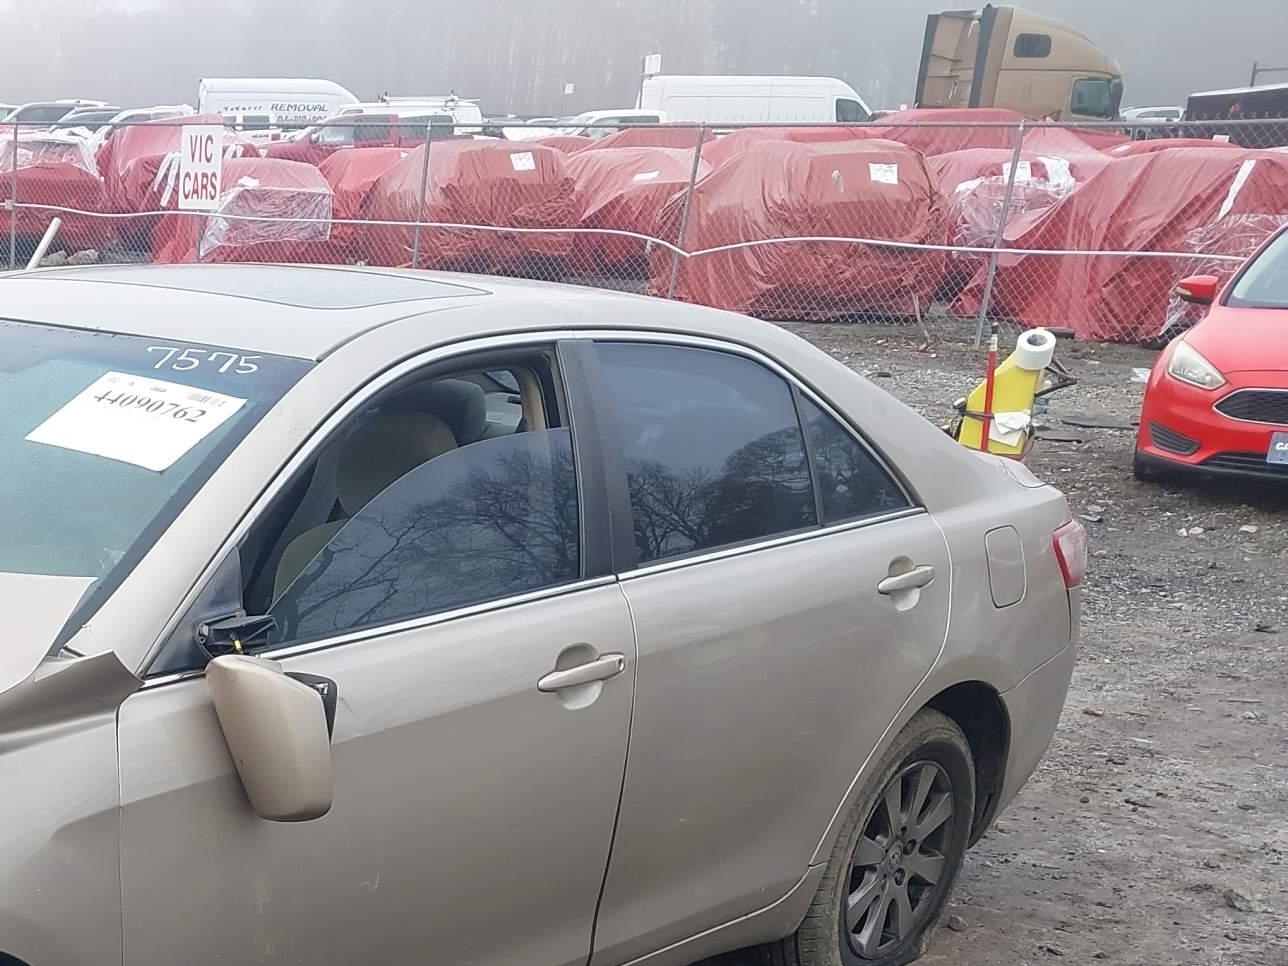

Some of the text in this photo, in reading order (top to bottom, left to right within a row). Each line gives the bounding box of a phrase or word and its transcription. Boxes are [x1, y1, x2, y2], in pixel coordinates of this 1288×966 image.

[270, 103, 329, 113] REMOVAL
[189, 134, 214, 163] VIC
[182, 171, 218, 200] CARS
[146, 346, 263, 374] 7575
[94, 390, 207, 422] 44090762
